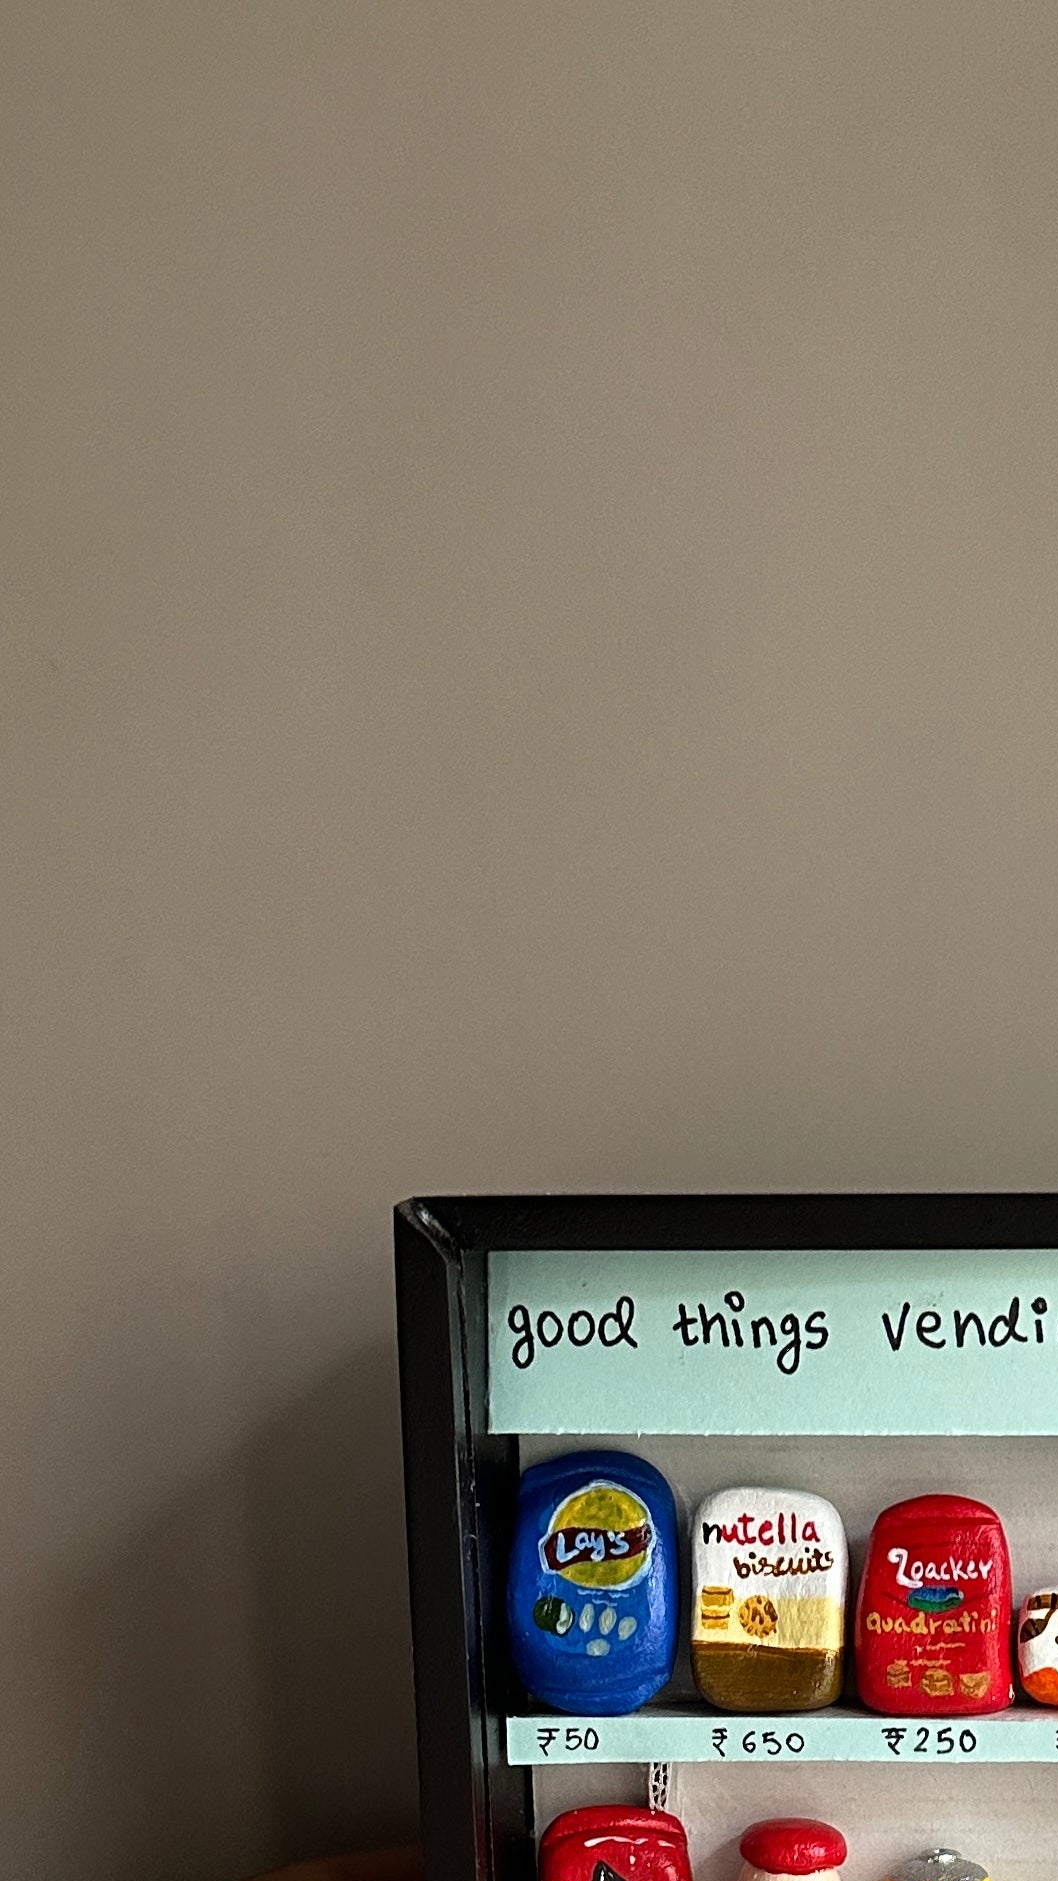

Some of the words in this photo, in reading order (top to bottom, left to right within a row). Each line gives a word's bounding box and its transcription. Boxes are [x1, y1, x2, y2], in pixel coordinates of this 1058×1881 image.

[507, 1296, 638, 1369] good
[673, 1291, 829, 1374] things
[703, 1512, 821, 1544] nutella
[556, 1530, 630, 1563] Lay's
[733, 1547, 835, 1579] biscuits
[887, 1548, 993, 1587] Loacker
